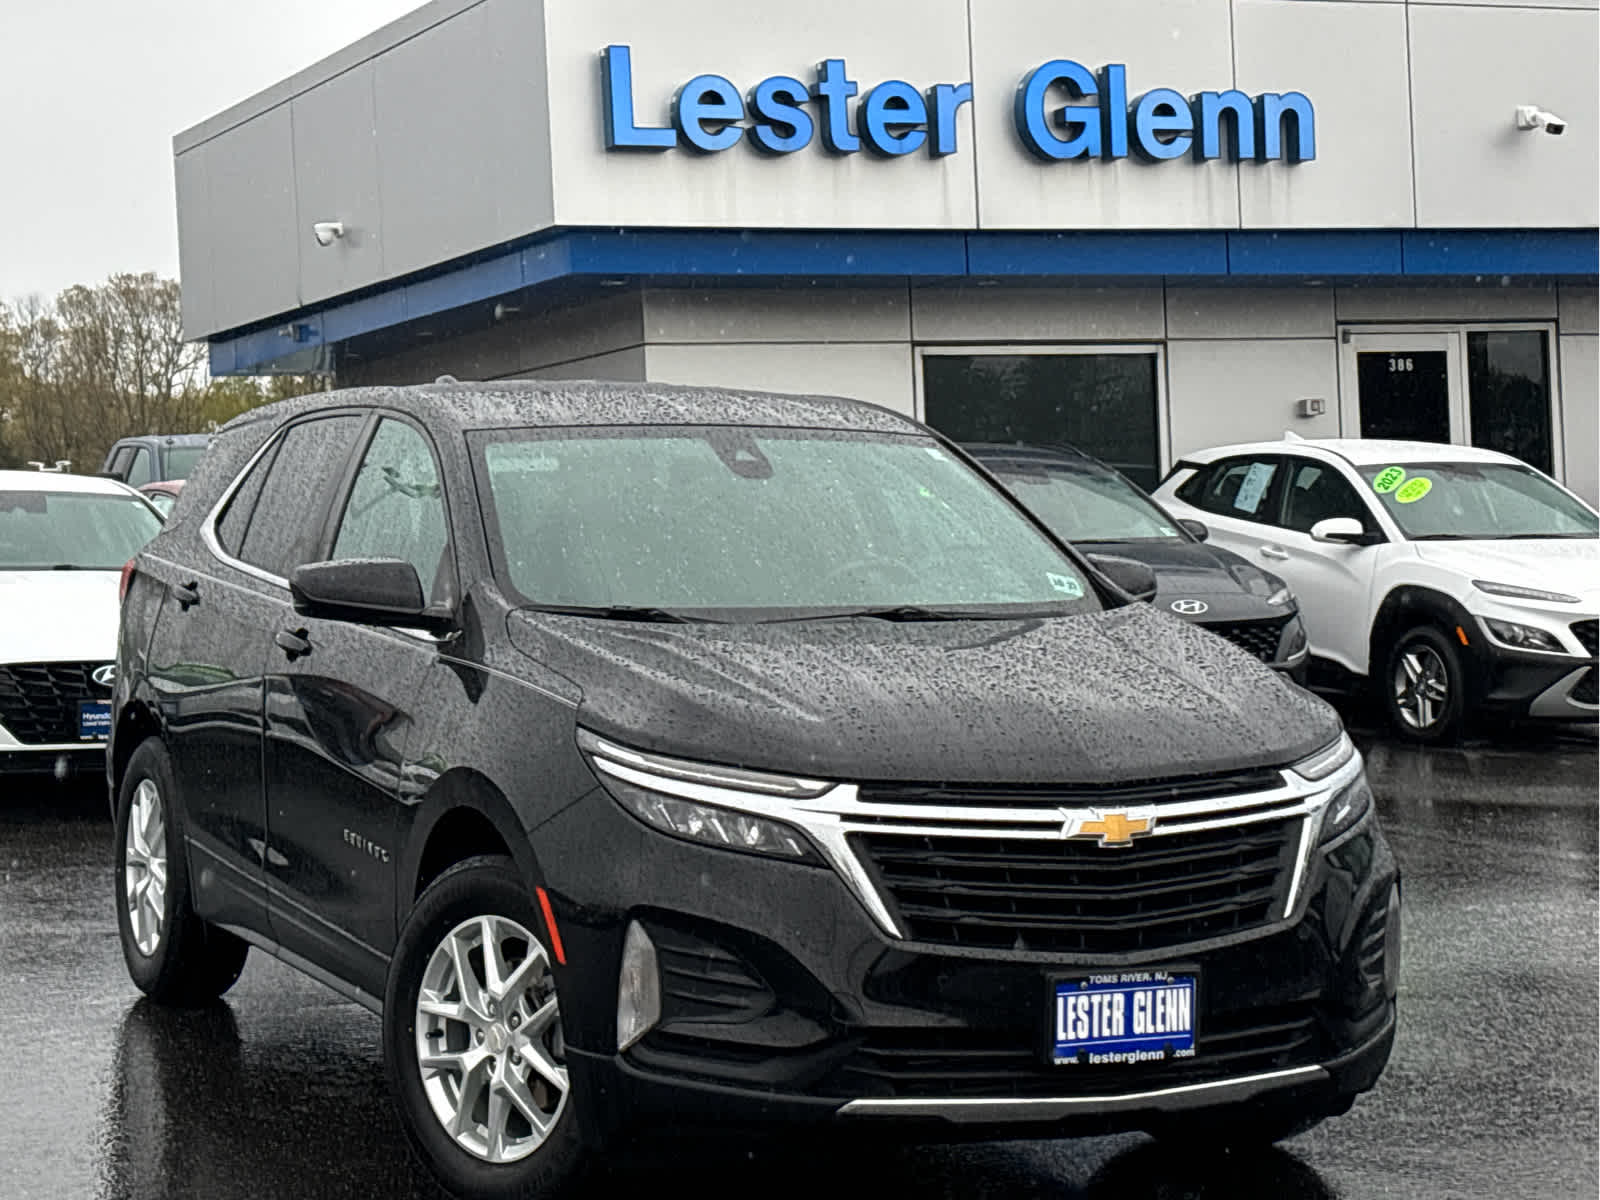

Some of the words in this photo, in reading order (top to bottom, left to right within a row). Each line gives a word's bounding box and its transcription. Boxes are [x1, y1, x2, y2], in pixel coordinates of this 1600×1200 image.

[601, 44, 972, 157] Lester
[1015, 58, 1317, 162] Glenn
[1388, 358, 1414, 371] 386
[1089, 975, 1118, 984] TOMS
[1056, 992, 1125, 1041] LESTER
[1132, 988, 1191, 1035] GLENN
[1089, 1050, 1165, 1065] lesterglenn
